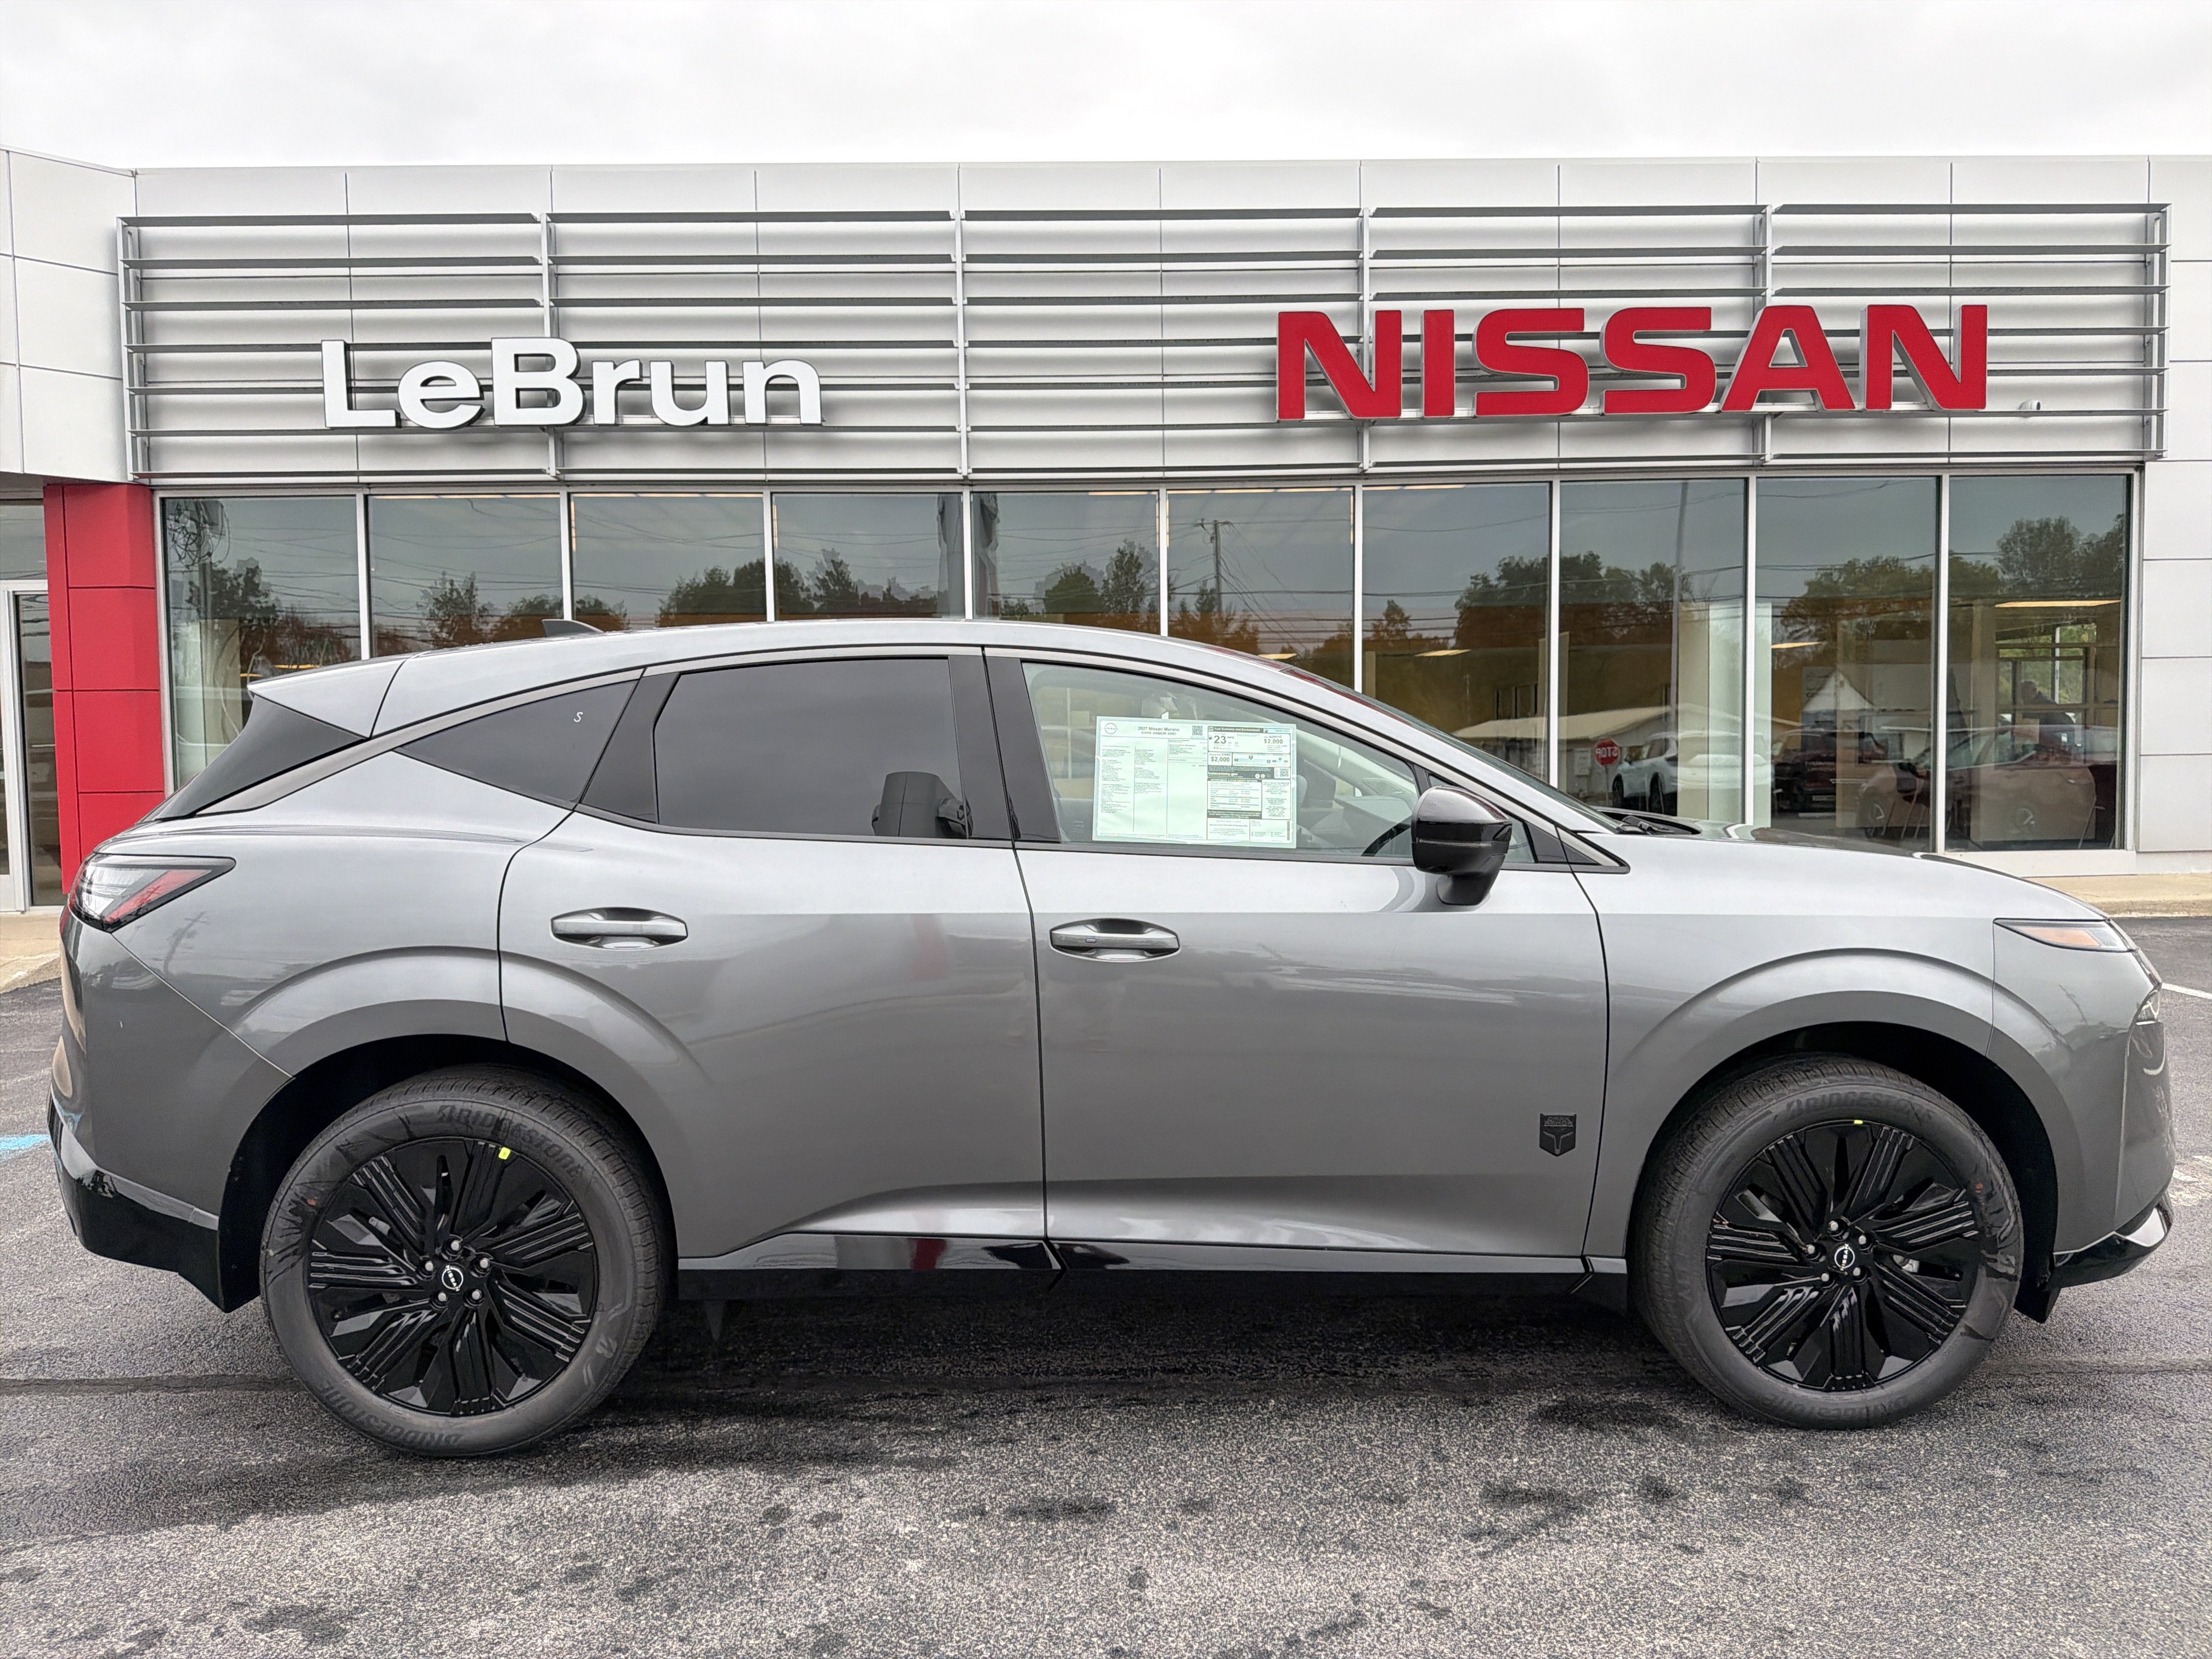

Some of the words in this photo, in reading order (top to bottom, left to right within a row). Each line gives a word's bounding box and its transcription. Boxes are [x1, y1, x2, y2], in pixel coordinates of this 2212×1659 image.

[321, 336, 824, 430] LeBrun
[1277, 304, 1988, 421] NISSAN
[1214, 735, 1226, 744] 23
